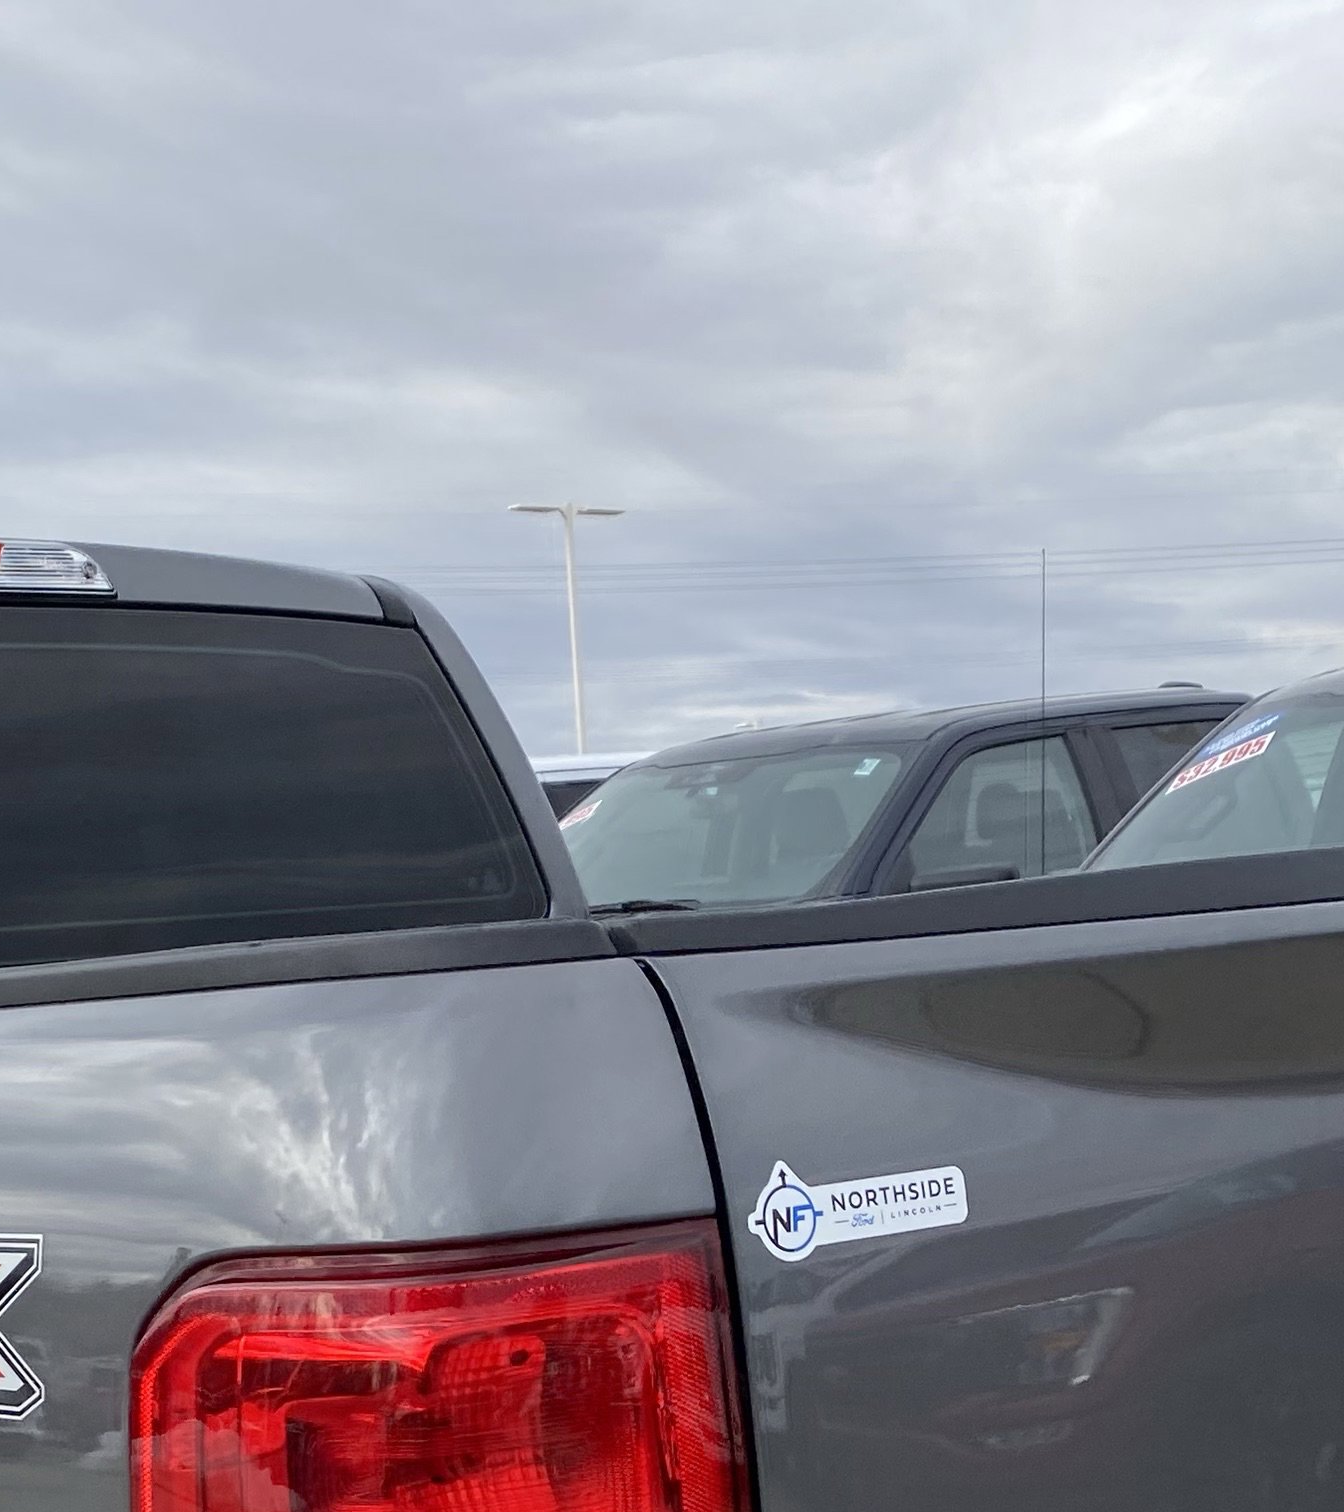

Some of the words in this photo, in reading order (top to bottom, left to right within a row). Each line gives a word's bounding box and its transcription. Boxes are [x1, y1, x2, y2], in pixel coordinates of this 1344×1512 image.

[831, 1177, 956, 1213] NORTHSIDE
[771, 1203, 813, 1245] NF
[850, 1212, 875, 1228] Ford
[890, 1205, 942, 1219] LINCOLN
